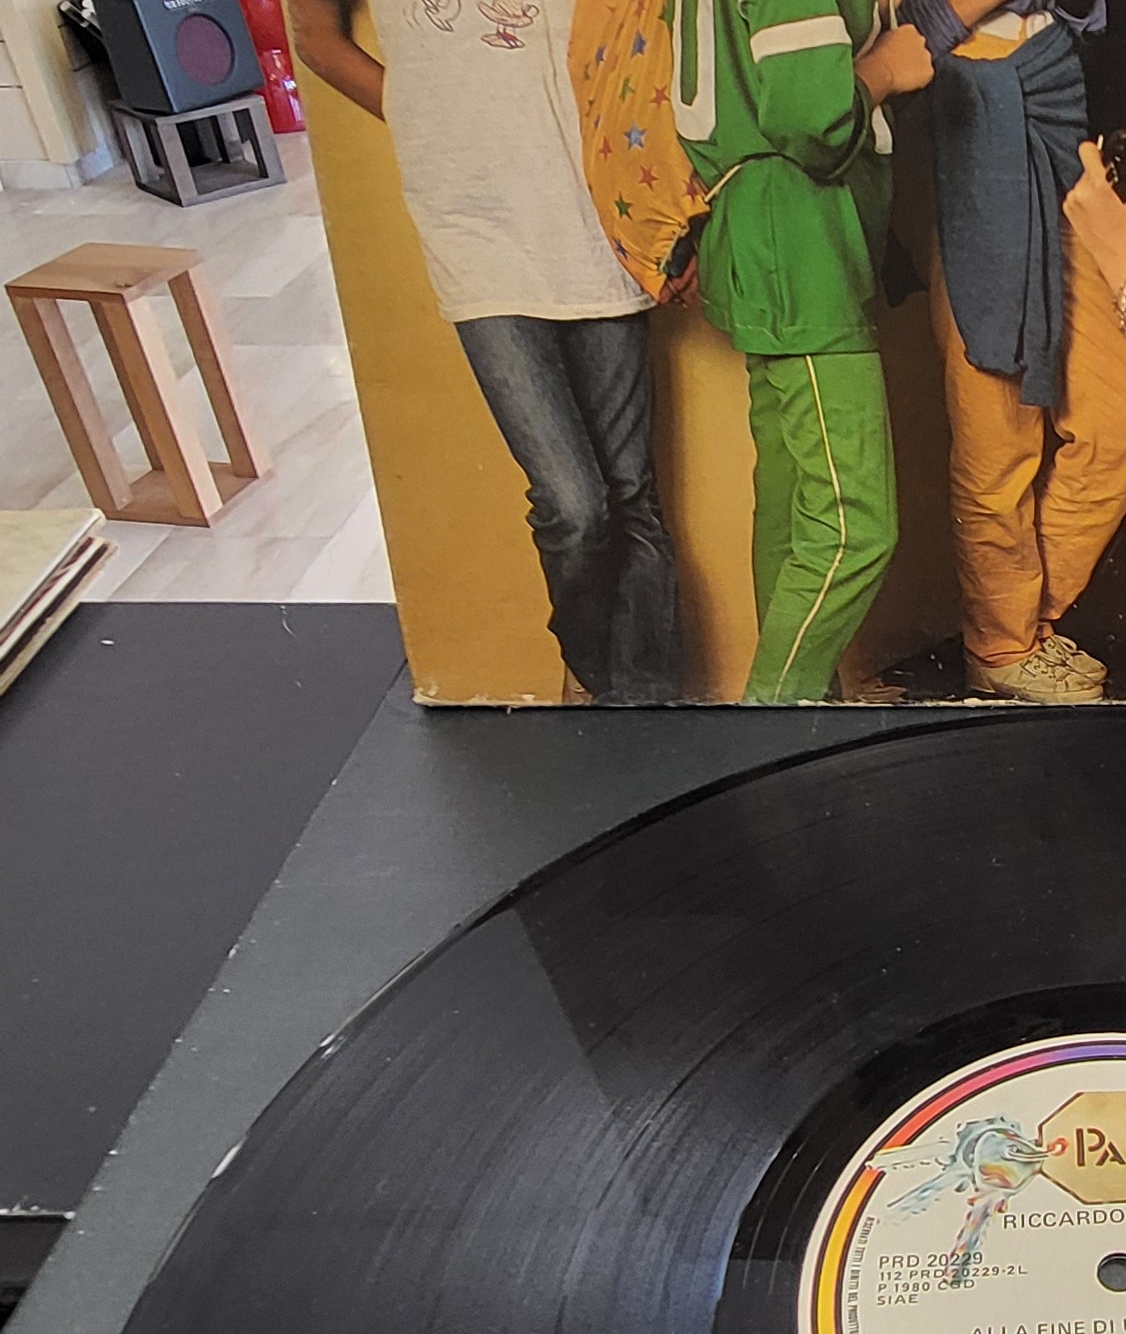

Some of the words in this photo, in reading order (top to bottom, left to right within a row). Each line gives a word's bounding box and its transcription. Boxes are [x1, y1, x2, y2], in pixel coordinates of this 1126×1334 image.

[1003, 1208, 1125, 1229] RICCARDO
[879, 1254, 920, 1269] PRD
[927, 1251, 983, 1267] 20229
[880, 1271, 902, 1281] 112
[909, 1268, 945, 1279] PRD
[894, 1281, 930, 1293] 1980
[876, 1293, 919, 1306] SIAE
[1093, 1319, 1115, 1334] DI
